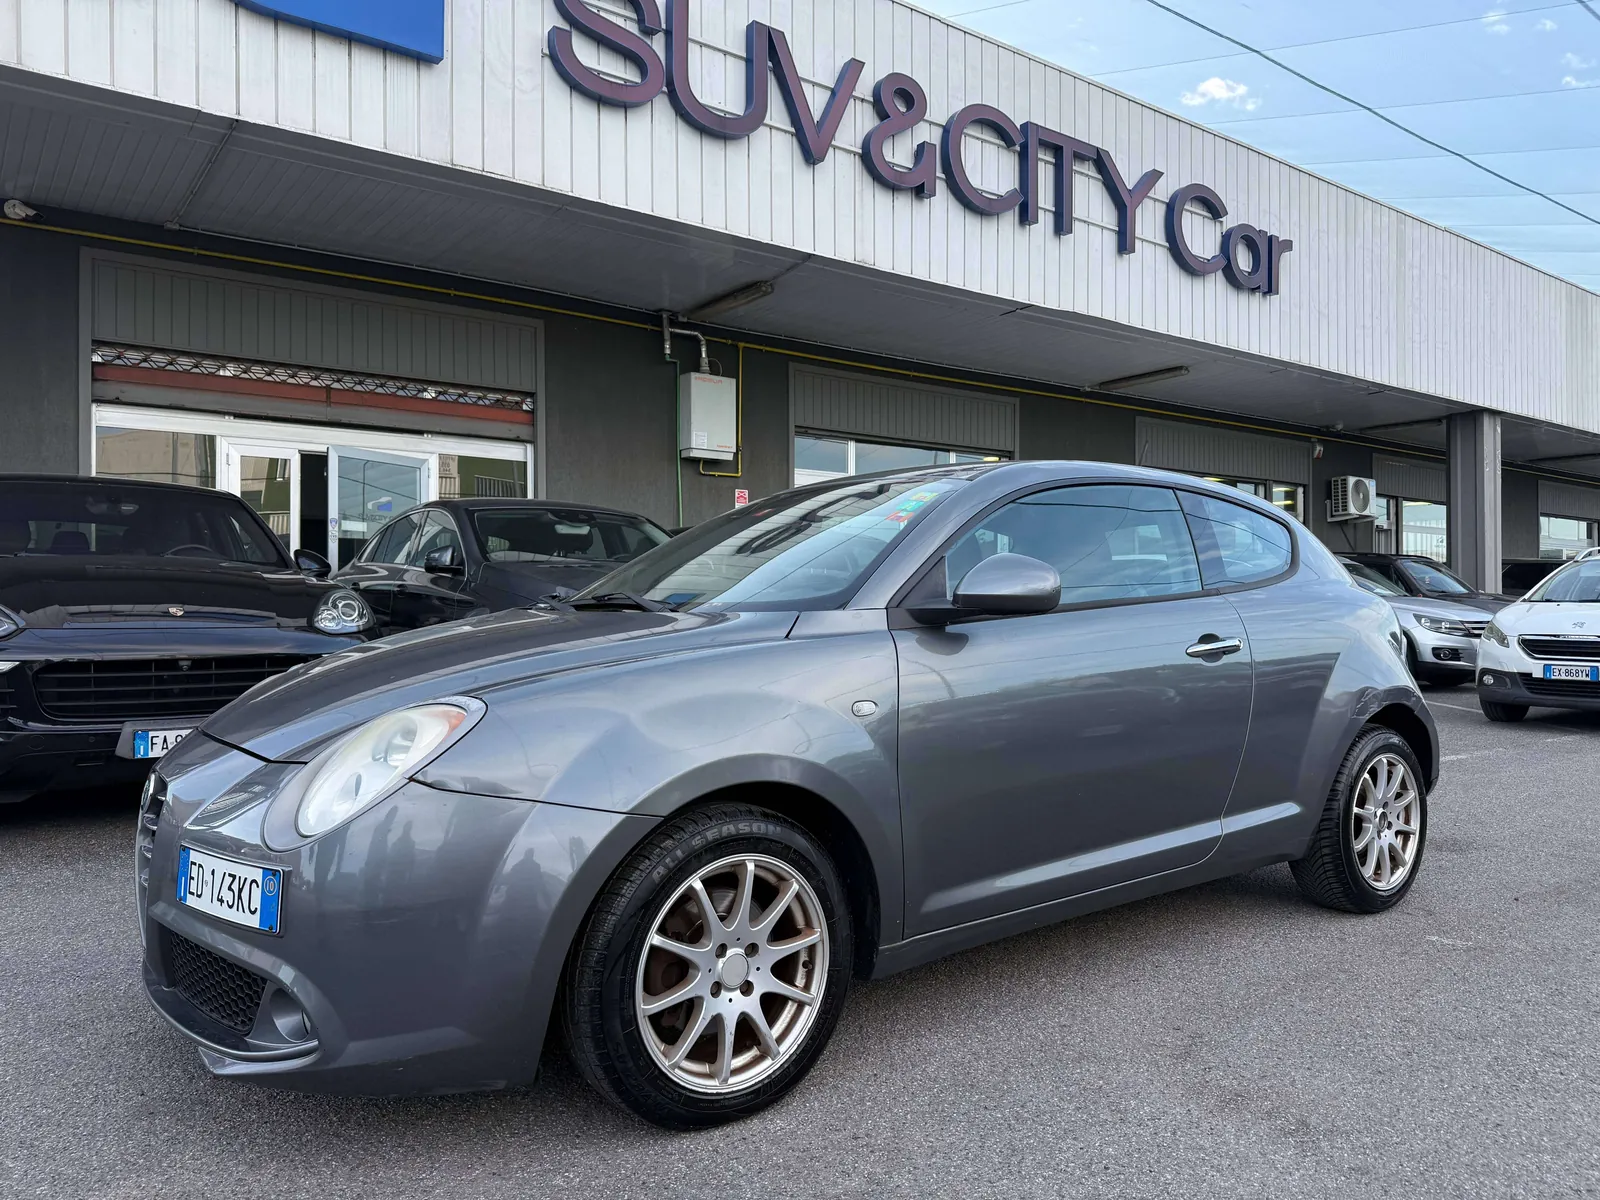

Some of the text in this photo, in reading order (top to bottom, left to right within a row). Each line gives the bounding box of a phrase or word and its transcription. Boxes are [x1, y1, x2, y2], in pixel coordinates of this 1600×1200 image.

[1165, 183, 1293, 296] Car
[652, 822, 783, 884] ALL SEASON
